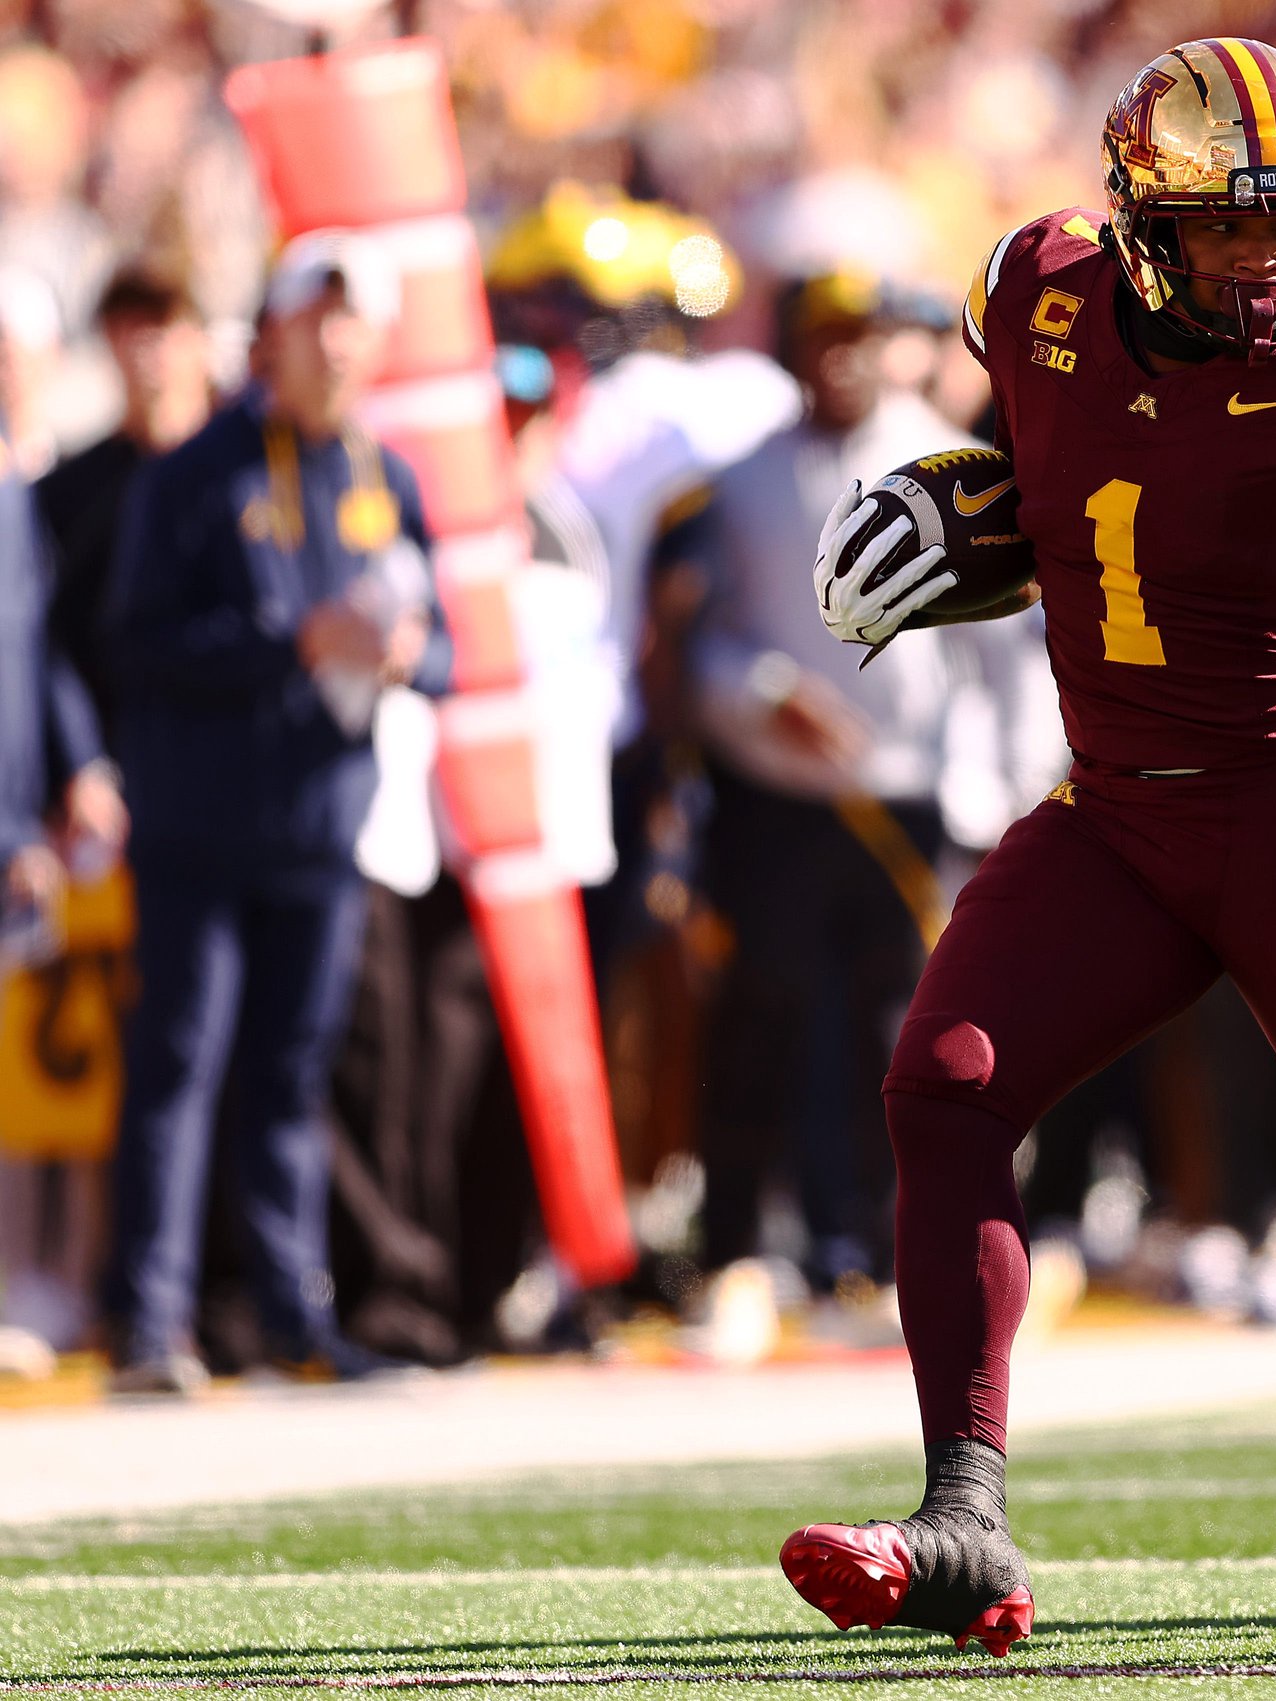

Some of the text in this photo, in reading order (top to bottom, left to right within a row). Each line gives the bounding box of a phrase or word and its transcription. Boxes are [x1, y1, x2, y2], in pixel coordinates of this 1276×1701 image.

[1034, 291, 1079, 335] C
[1128, 392, 1157, 419] M
[1084, 478, 1167, 666] 1
